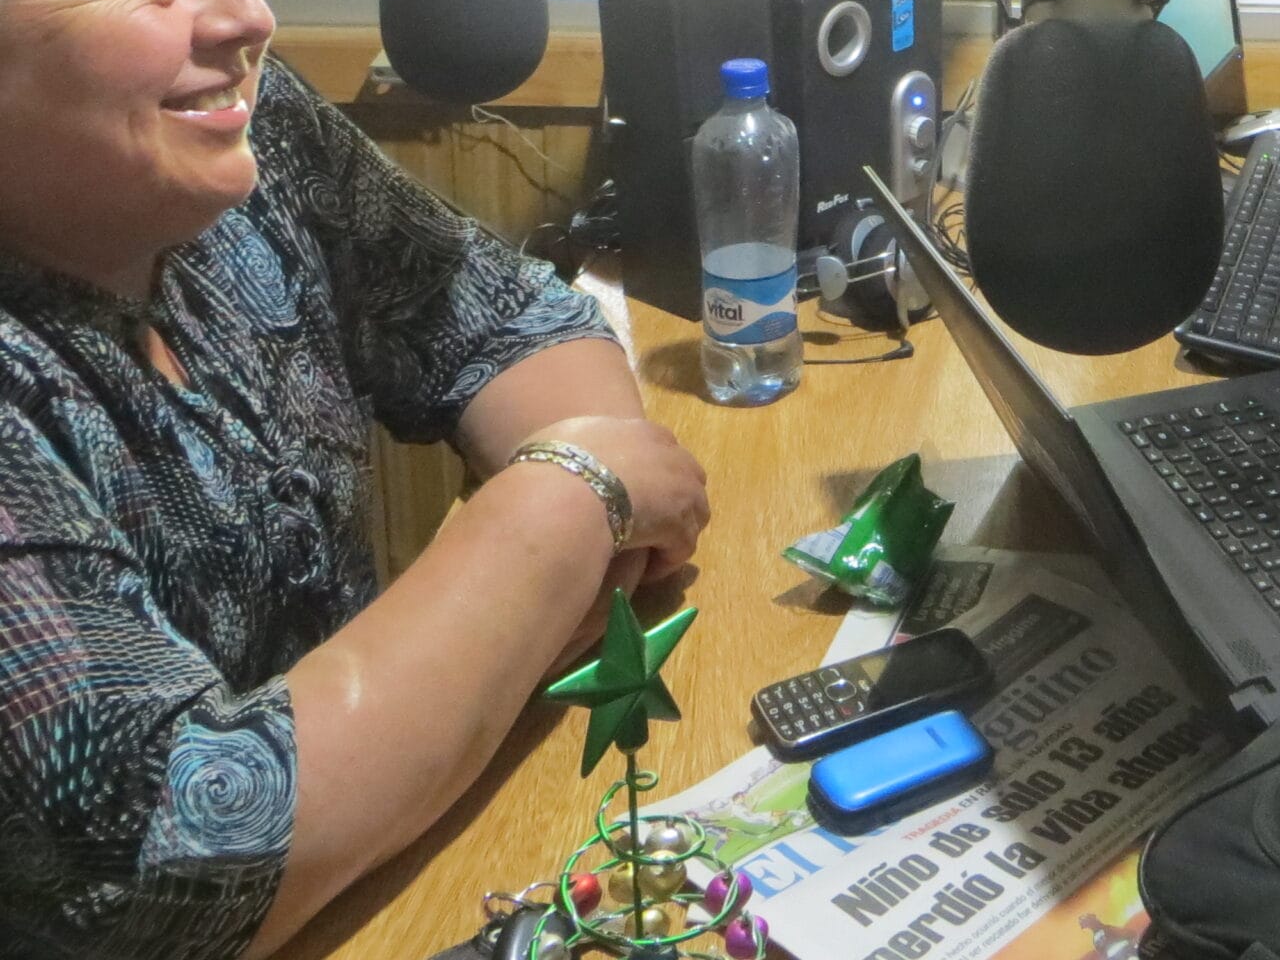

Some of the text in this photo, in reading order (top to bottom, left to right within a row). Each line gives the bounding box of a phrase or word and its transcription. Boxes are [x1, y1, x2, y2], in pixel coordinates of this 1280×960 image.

[831, 854, 940, 927] Niño
[928, 823, 991, 858] de
[1048, 736, 1104, 773] 13
[1093, 684, 1178, 743] años
[959, 794, 979, 809] EN
[984, 841, 1046, 879] la
[1031, 789, 1122, 844] vida
